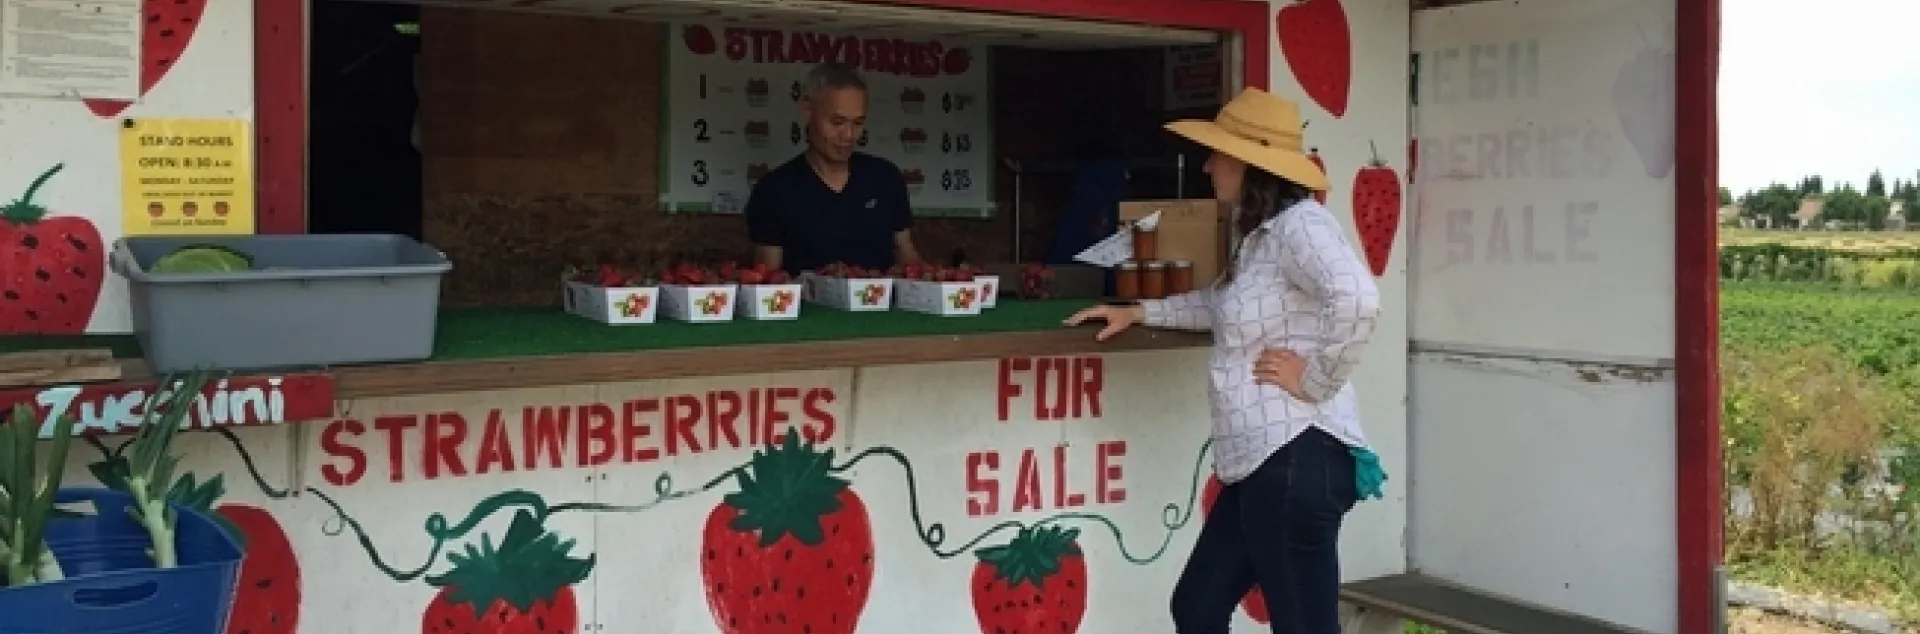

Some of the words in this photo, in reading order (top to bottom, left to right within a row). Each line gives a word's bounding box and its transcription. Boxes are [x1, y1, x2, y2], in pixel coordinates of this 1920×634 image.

[724, 27, 943, 78] STRAWBERRIES
[693, 118, 711, 144] 2
[691, 159, 710, 187] 3
[1445, 202, 1599, 265] SALE
[997, 356, 1103, 421] FOR
[320, 386, 837, 486] STRAWBERRIES
[965, 440, 1127, 518] SALE
